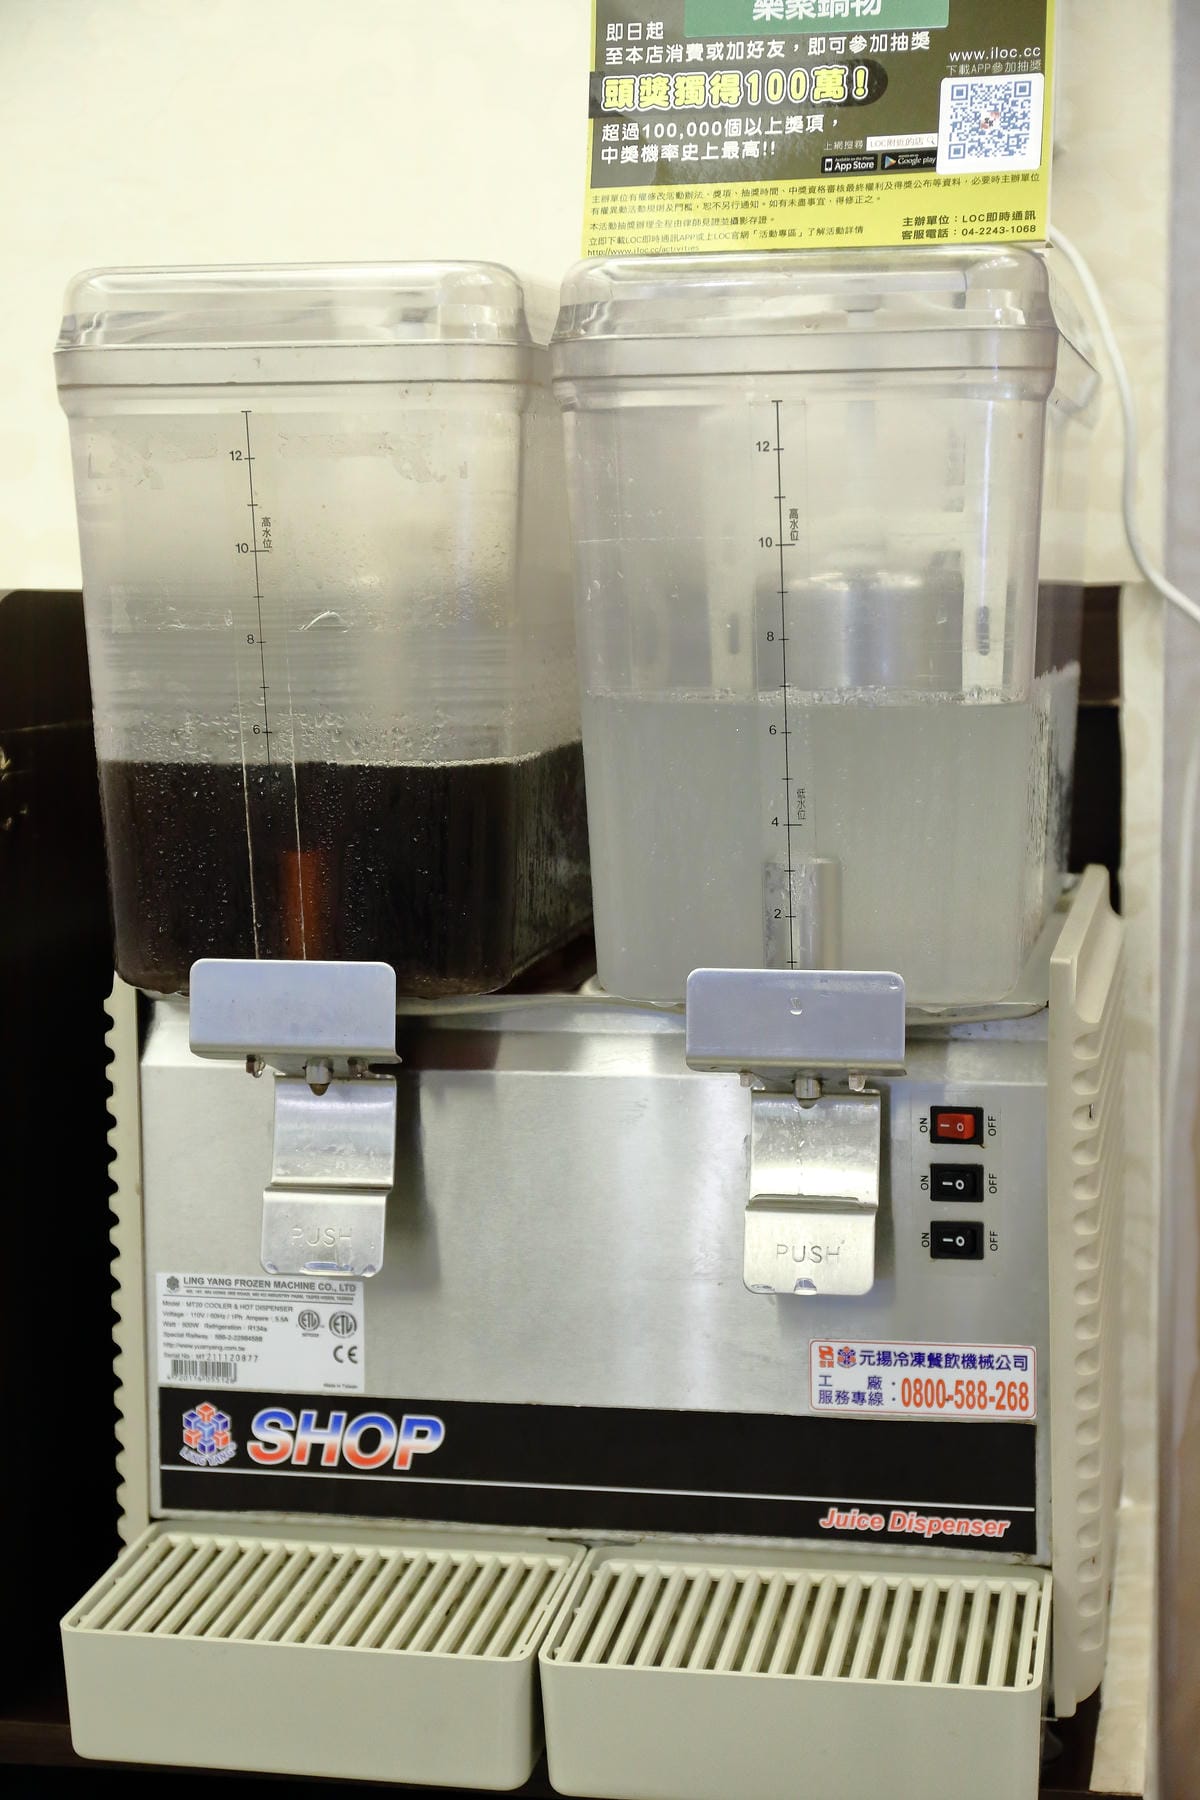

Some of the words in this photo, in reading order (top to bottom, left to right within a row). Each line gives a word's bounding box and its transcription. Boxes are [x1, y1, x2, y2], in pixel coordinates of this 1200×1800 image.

[605, 21, 664, 42] 即日起
[605, 31, 930, 65] 至本店消費或加好友，即可參加抽獎
[949, 47, 1041, 62] www.iloc.cc
[946, 60, 1042, 76] 下載APP參加抽獎
[824, 139, 864, 151] 上網搜尋
[834, 162, 852, 172] App
[853, 160, 875, 170] Store
[897, 156, 922, 166] Google
[922, 156, 937, 165] play
[902, 210, 1036, 227] 主辦單位：LOC即時通訊
[901, 225, 1037, 241] 客服電話：04-2243-1068
[756, 440, 770, 452] 12
[229, 450, 243, 461] 12
[261, 516, 272, 549] 高水位
[788, 508, 799, 541] 高水位
[235, 543, 249, 554] 10
[758, 537, 773, 548] 10
[247, 634, 255, 645] 8
[767, 631, 775, 642] 8
[253, 724, 260, 735] 6
[769, 724, 777, 735] 6
[771, 816, 779, 827] 4
[774, 908, 782, 919] 2
[919, 1117, 928, 1133] ON
[988, 1115, 997, 1137] OFF
[920, 1175, 929, 1191] ON
[989, 1173, 998, 1194] OFF
[291, 1227, 353, 1248] PUSH
[921, 1232, 930, 1248] ON
[990, 1230, 998, 1252] OFF
[776, 1243, 840, 1264] PUSH
[183, 1276, 204, 1285] LING
[207, 1277, 231, 1287] YANG
[234, 1279, 271, 1289] FROZEN
[274, 1281, 315, 1291] MACHINE
[318, 1283, 337, 1293] CO.,
[339, 1284, 356, 1293] LTD
[204, 1302, 232, 1310] COOLER
[255, 1305, 293, 1313] DISPENSER
[333, 1345, 358, 1365] CE
[859, 1349, 1028, 1371] 元揚冷凍餐飲機械公司
[818, 1374, 832, 1387] 工
[867, 1375, 883, 1391] 廠
[818, 1389, 884, 1406] 服務專線
[901, 1377, 1029, 1411] 0800-588-268
[247, 1406, 445, 1471] SHOP
[819, 1507, 885, 1531] Juice
[888, 1510, 1011, 1538] Dispenser
